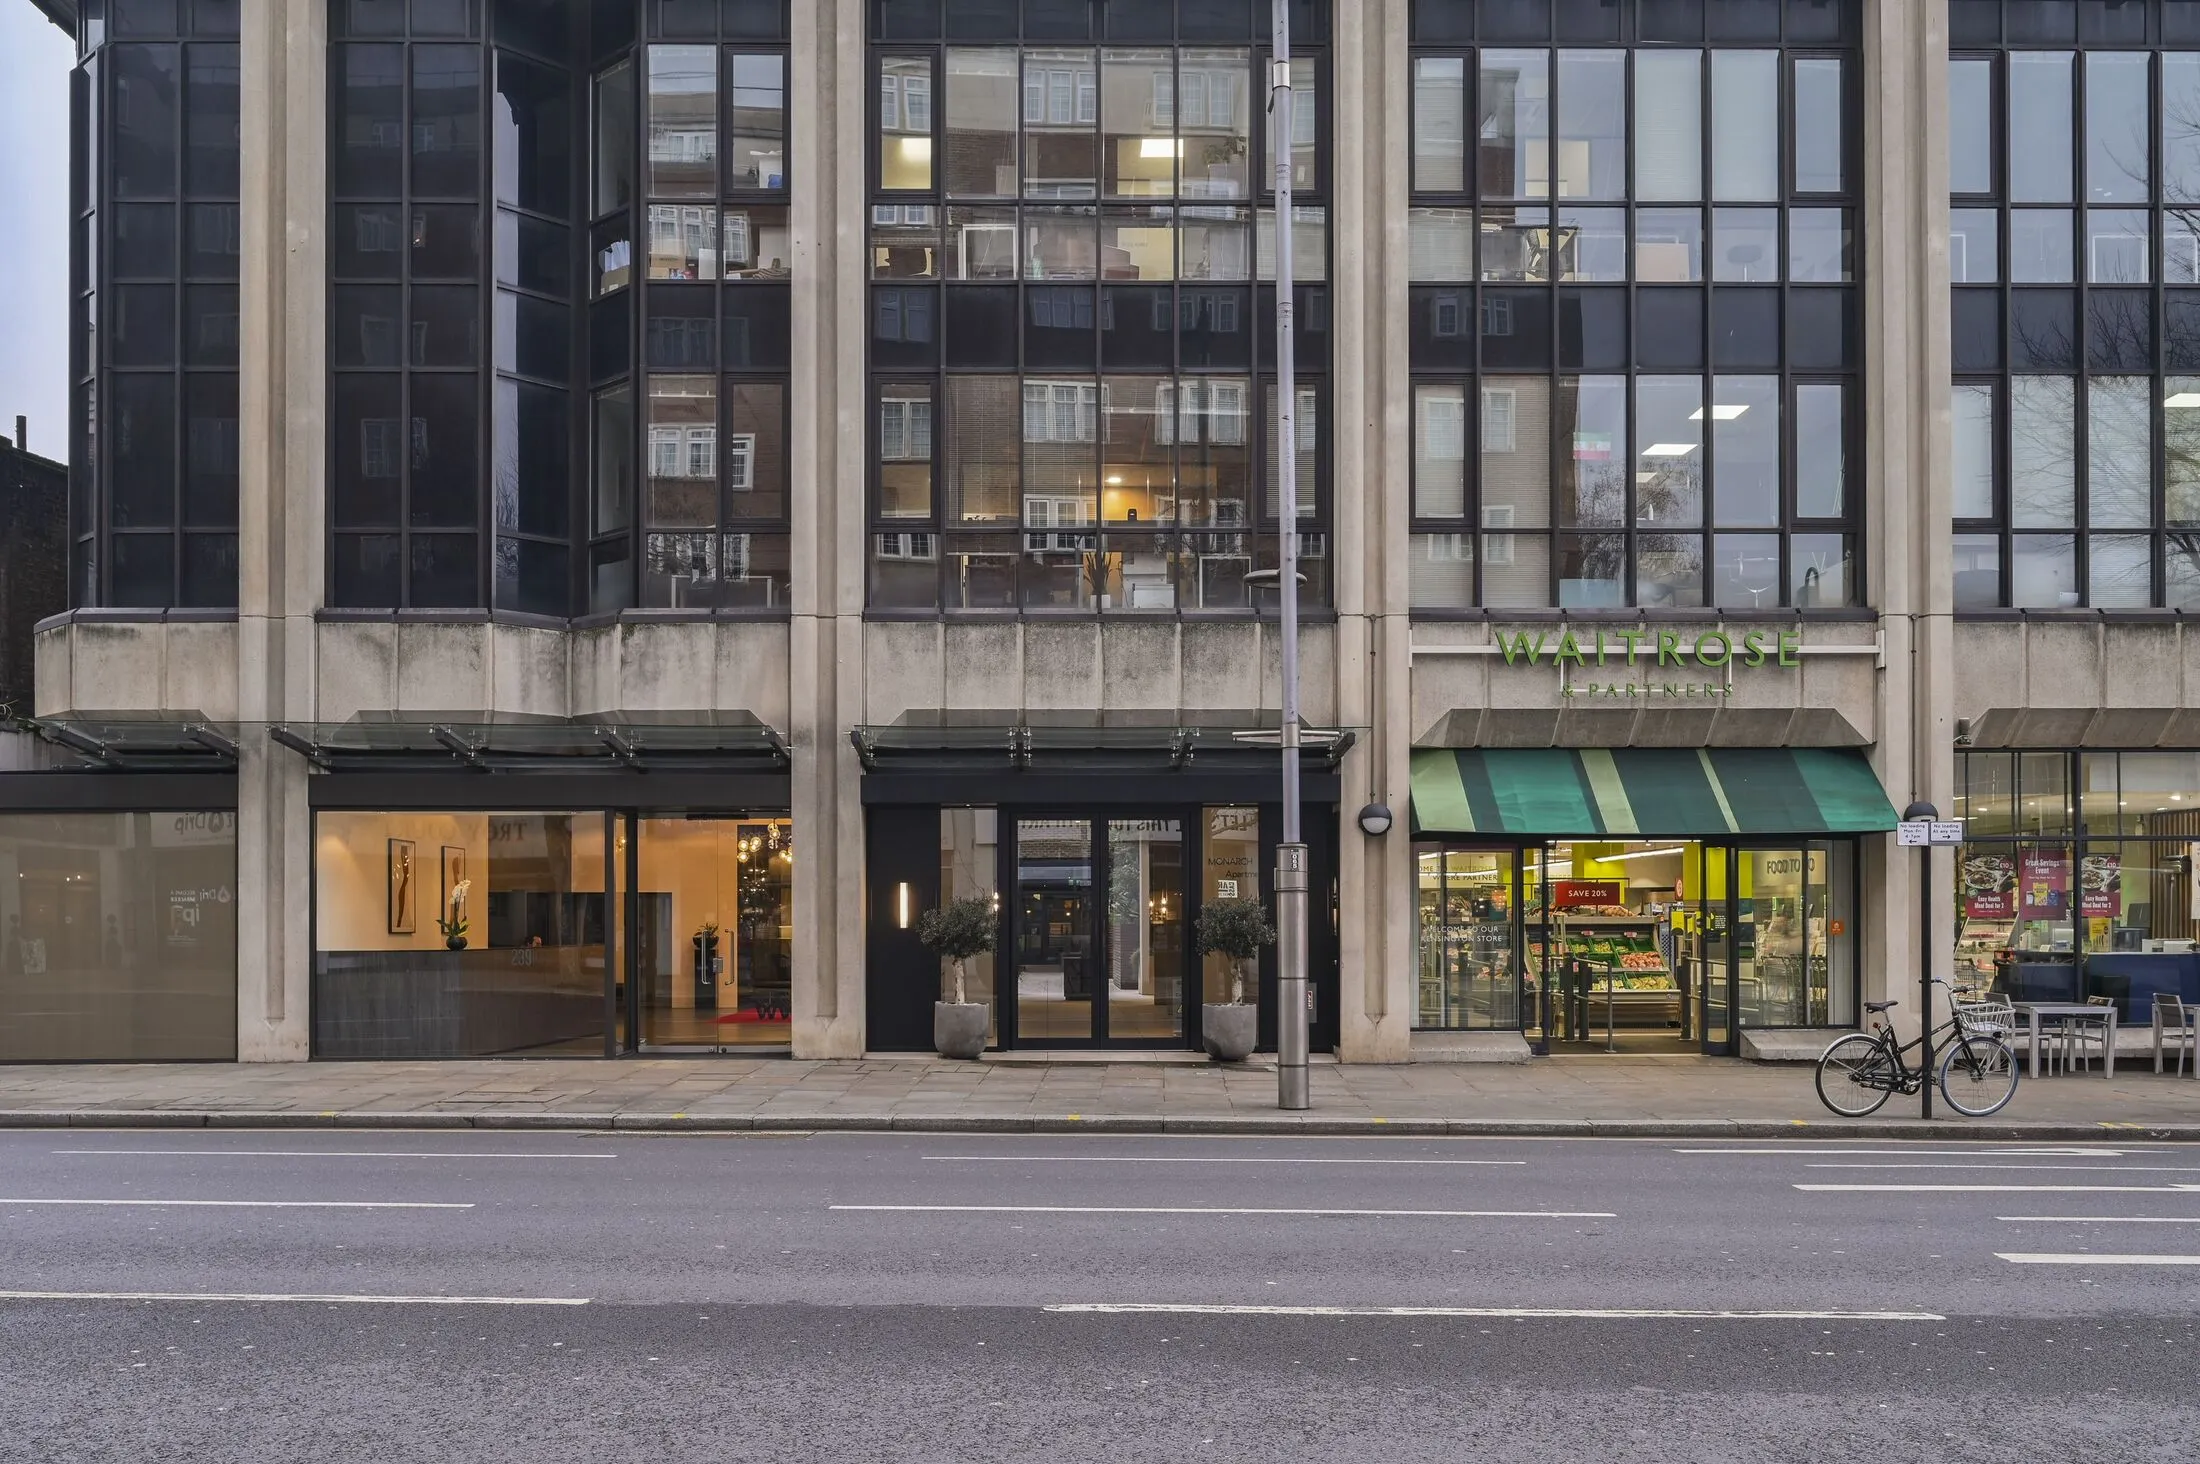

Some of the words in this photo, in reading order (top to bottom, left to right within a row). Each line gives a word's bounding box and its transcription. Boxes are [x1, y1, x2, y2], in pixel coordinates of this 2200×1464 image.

[1496, 630, 1800, 667] WAITROSE
[1561, 683, 1574, 698] &
[1588, 683, 1733, 698] PARTNERS
[1208, 857, 1253, 866] MONARCH
[2035, 866, 2050, 874] Event
[1591, 889, 1608, 897] 20%
[1424, 925, 1465, 933] WELCOME
[1467, 925, 1478, 933] TO
[1480, 925, 1499, 933] OUR
[1420, 935, 1475, 943] KENSINGTON
